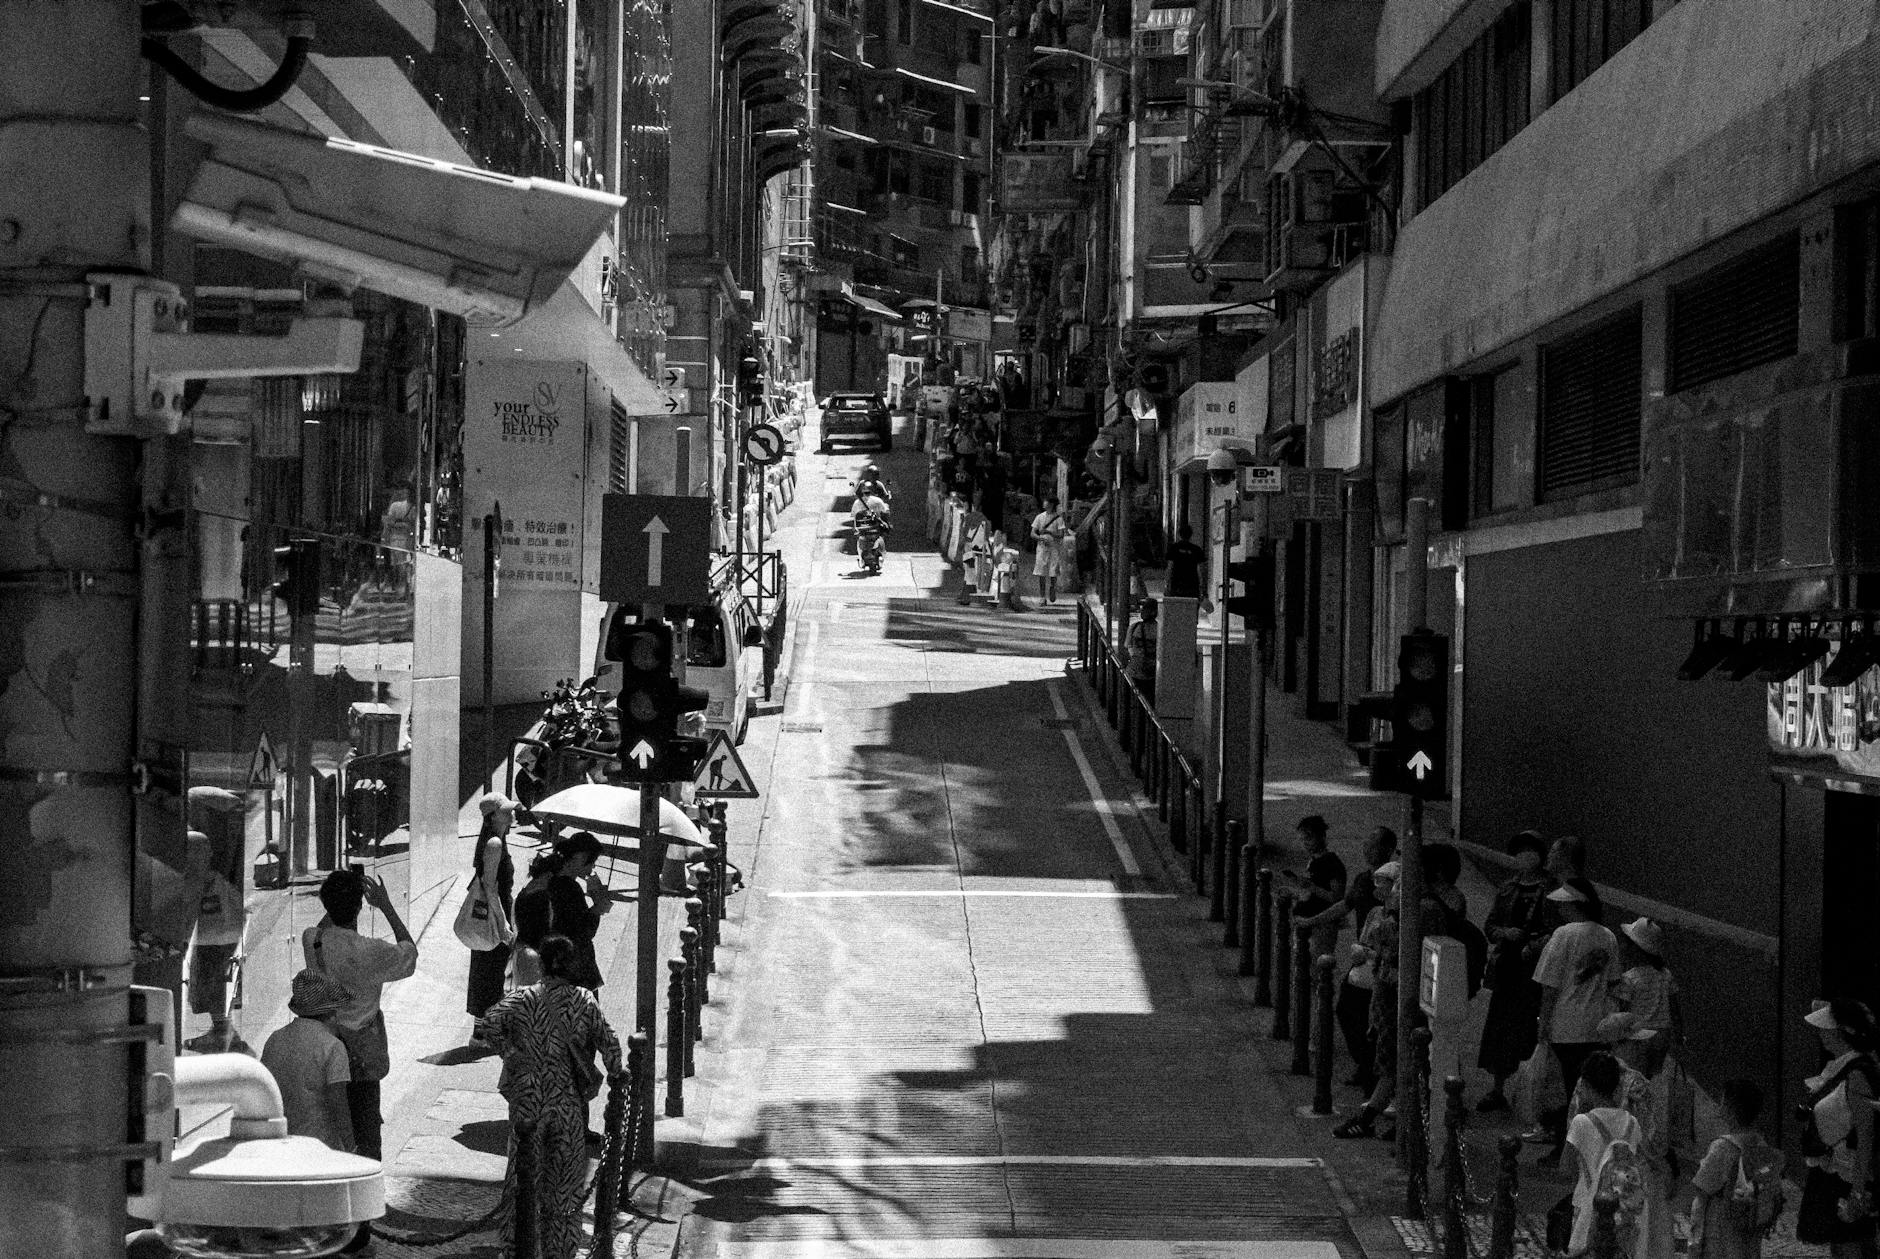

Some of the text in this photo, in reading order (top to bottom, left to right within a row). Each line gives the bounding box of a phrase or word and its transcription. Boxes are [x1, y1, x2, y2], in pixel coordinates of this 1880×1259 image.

[493, 402, 530, 417] your
[502, 413, 560, 428] ENDLESS
[502, 422, 556, 437] BEAUTY
